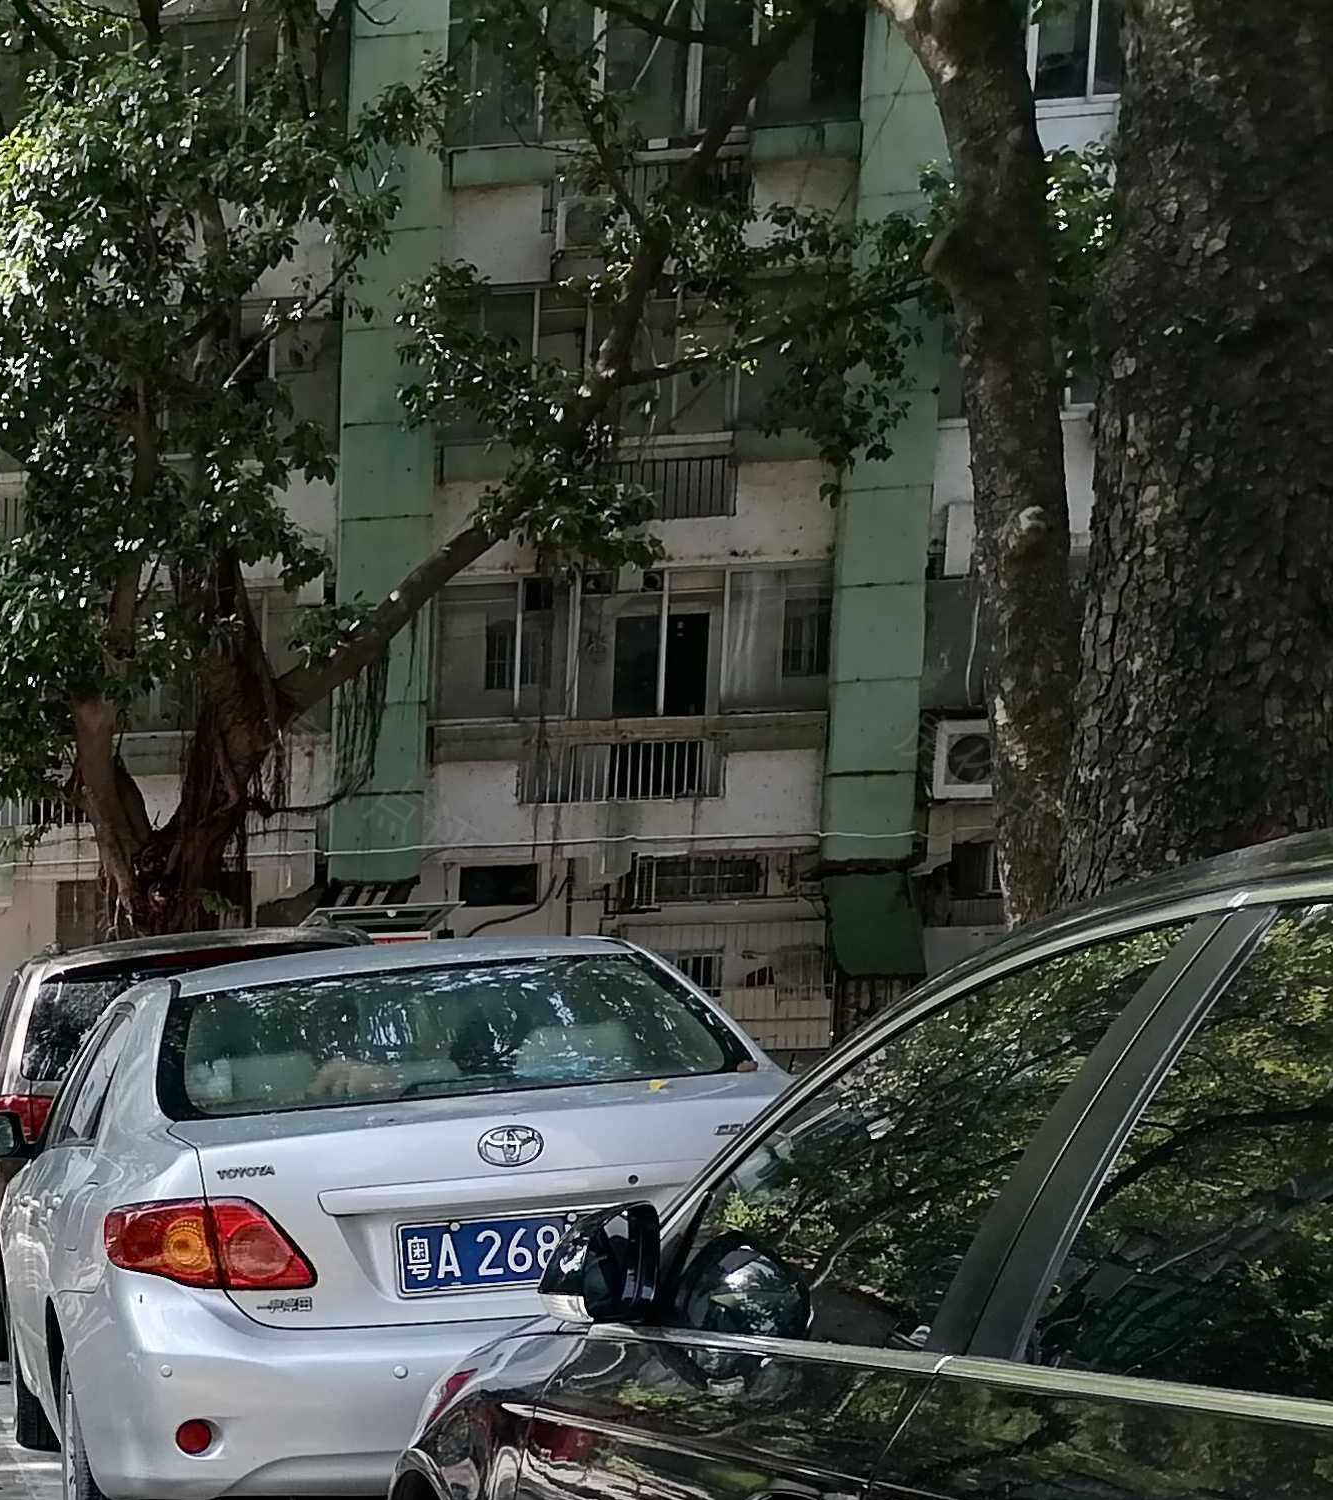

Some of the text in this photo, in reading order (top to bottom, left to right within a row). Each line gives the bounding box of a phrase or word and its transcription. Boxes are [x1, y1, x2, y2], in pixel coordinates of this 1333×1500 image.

[216, 1164, 275, 1180] TOYOTA
[406, 1223, 571, 1281] 粤A 268
